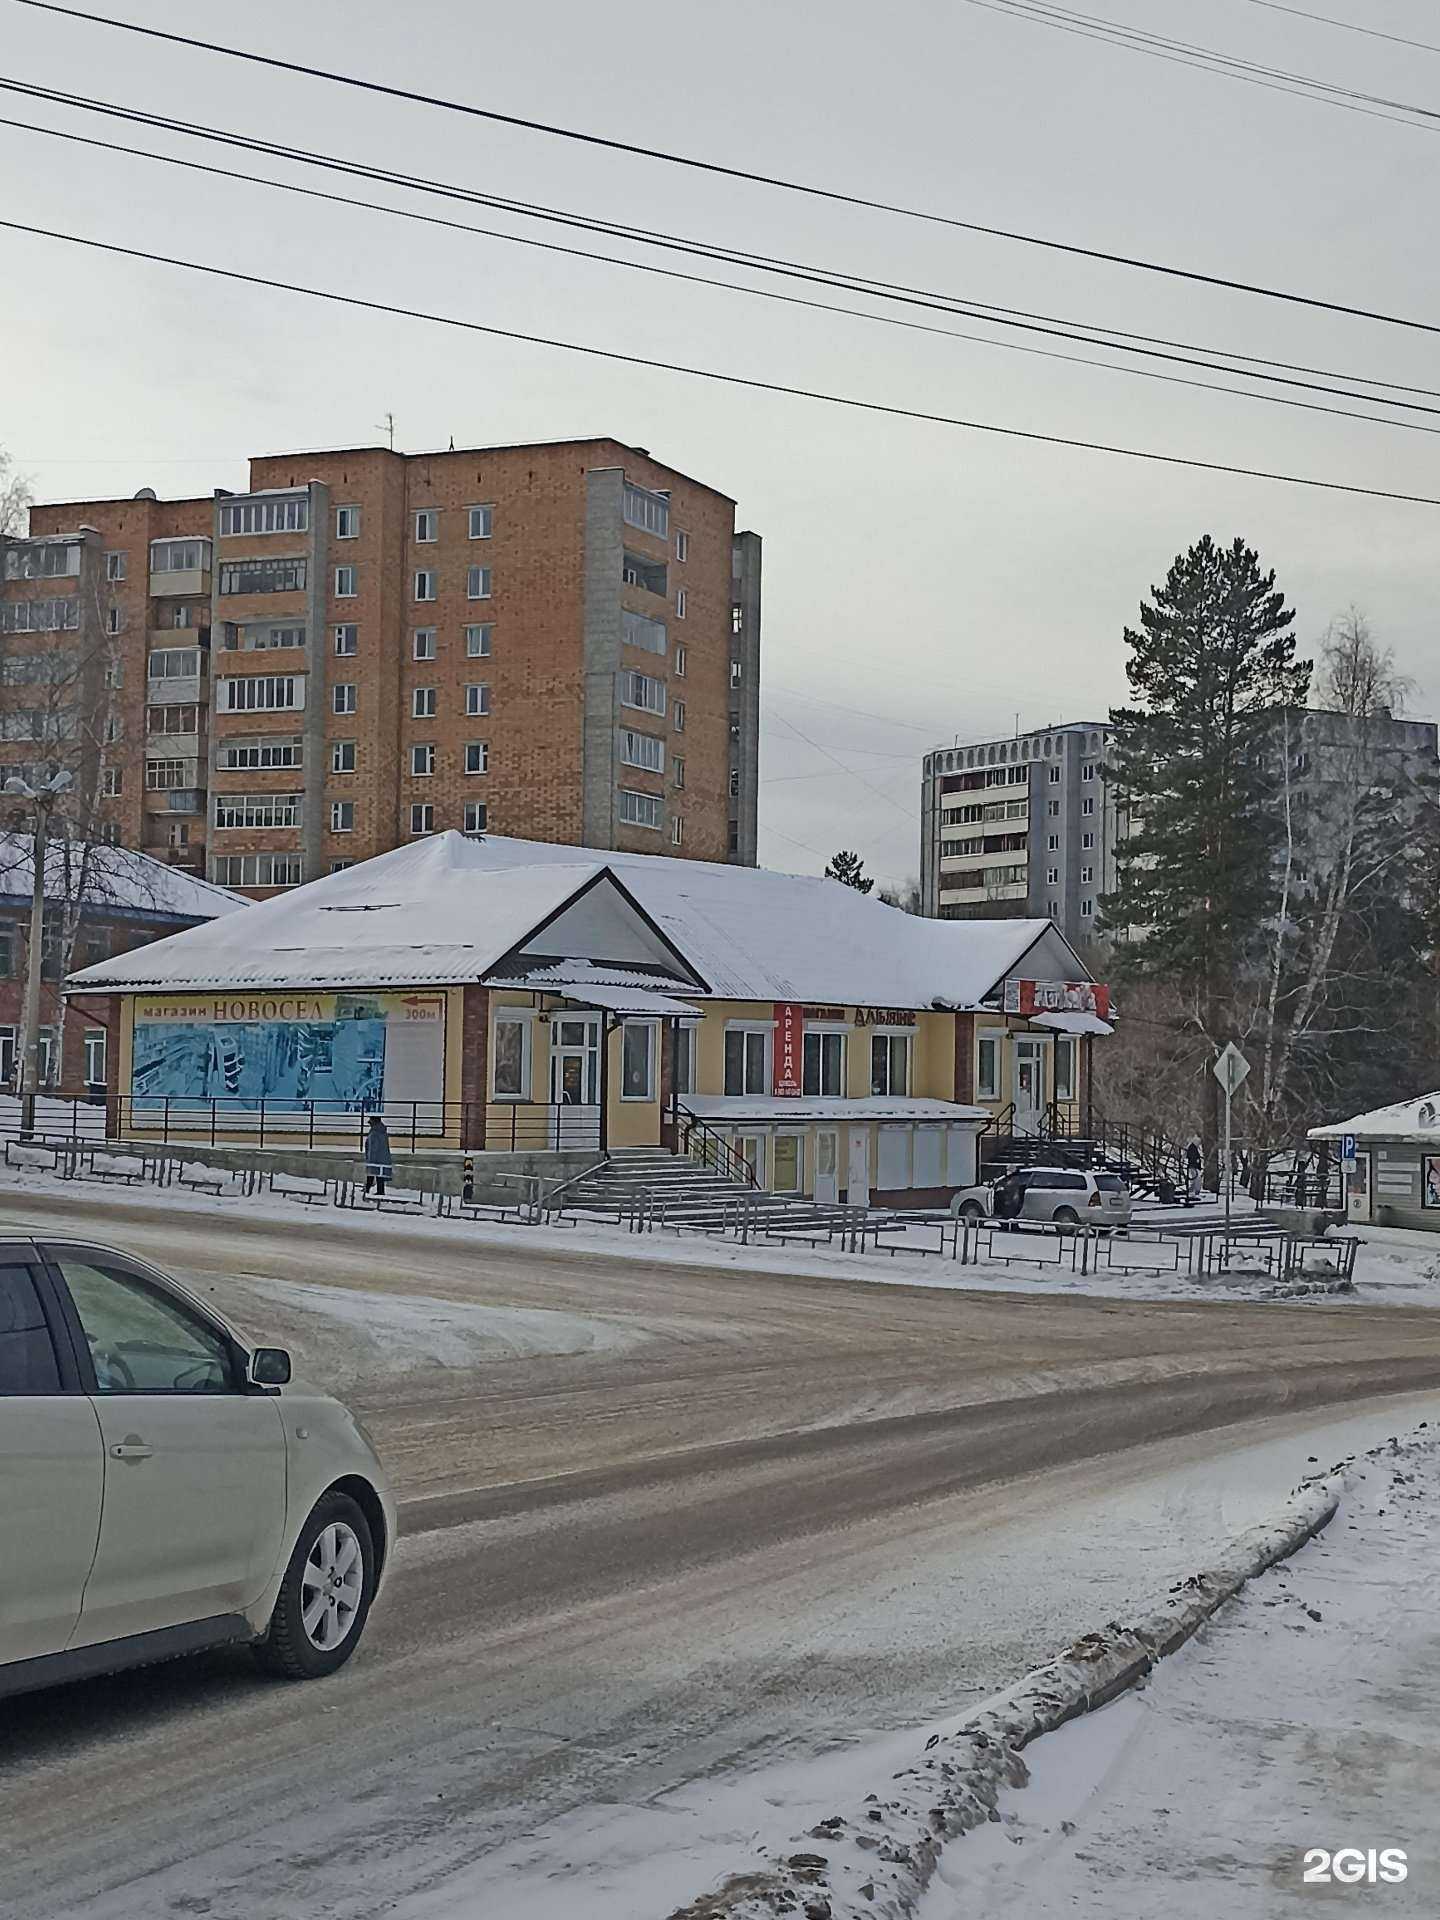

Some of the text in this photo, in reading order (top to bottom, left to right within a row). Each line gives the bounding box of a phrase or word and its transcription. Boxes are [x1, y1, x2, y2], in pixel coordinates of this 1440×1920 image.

[143, 1001, 323, 1020] магазин НОВОСЕЛ
[783, 1006, 793, 1080] АРЕНДА
